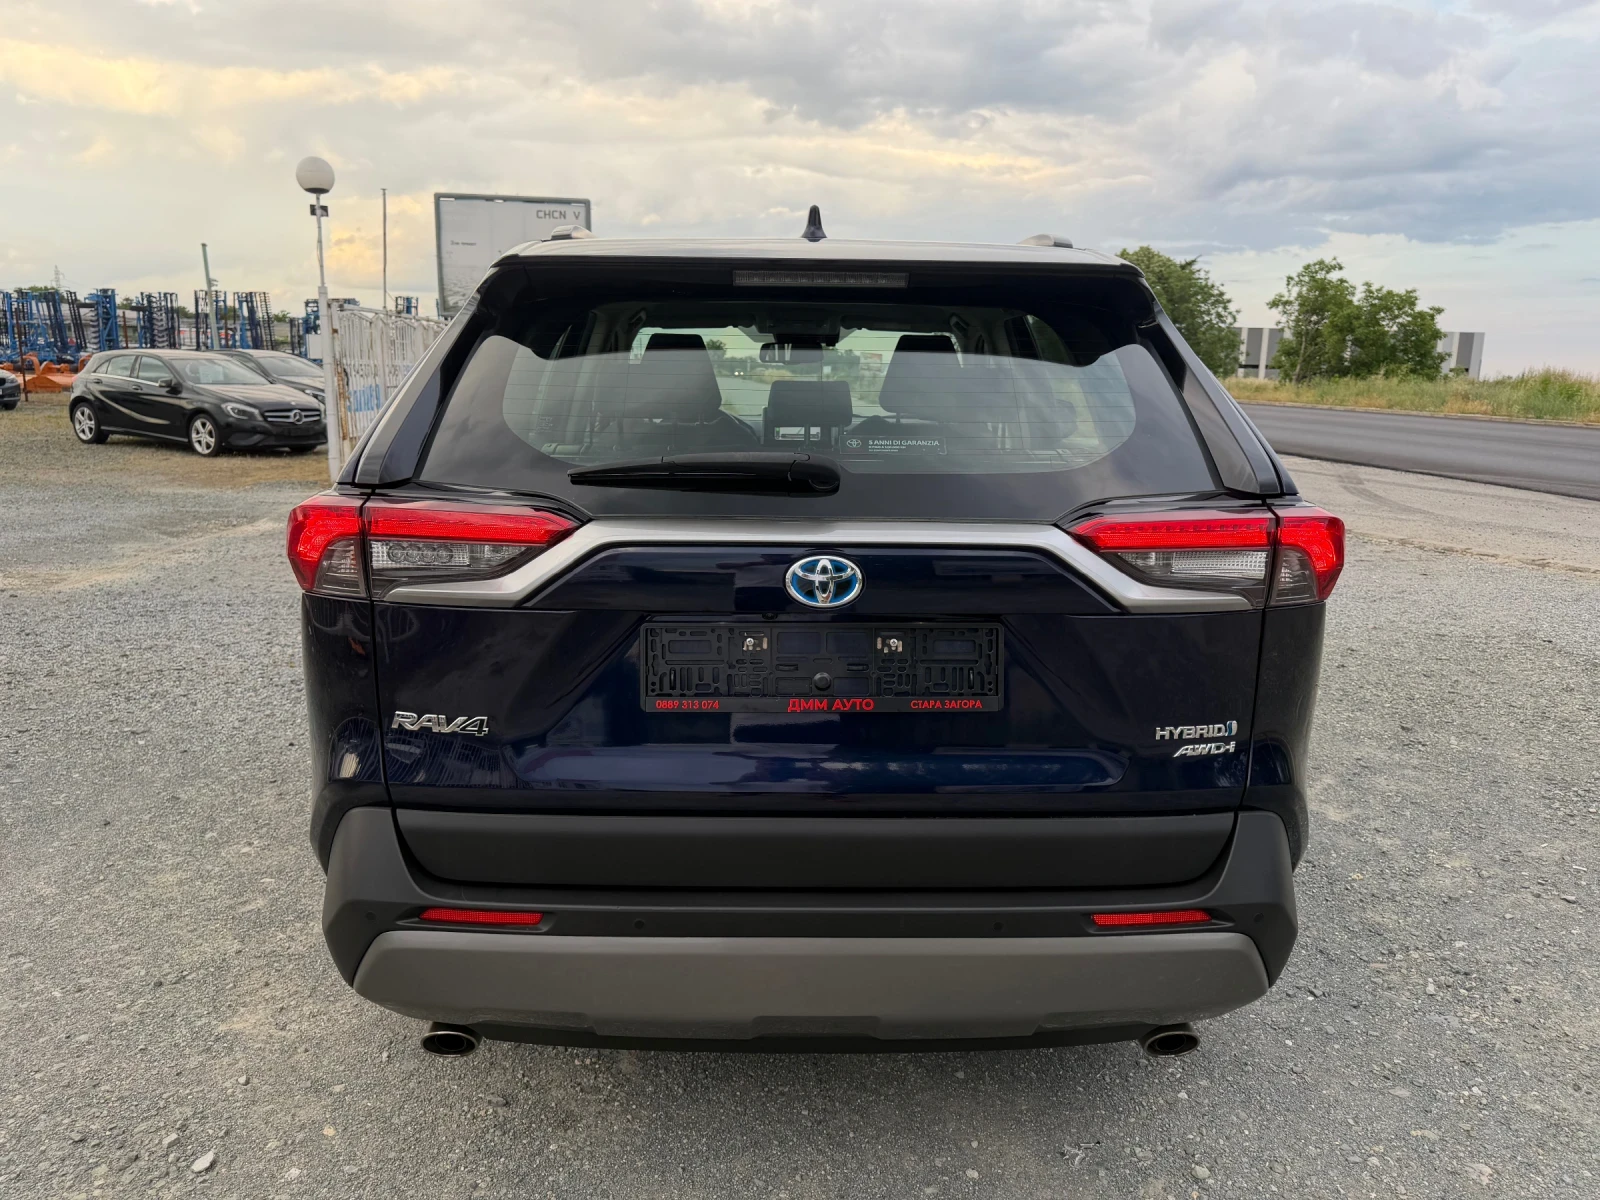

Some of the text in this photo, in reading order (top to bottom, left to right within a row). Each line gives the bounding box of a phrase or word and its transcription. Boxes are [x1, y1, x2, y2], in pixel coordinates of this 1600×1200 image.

[892, 439, 901, 447] DI
[655, 700, 719, 710] 0889 313 074
[787, 698, 875, 713] ДММ АУТО
[910, 700, 983, 709] СТАРА ЗАГОРА
[391, 710, 489, 737] RAV4
[1155, 723, 1227, 740] HYBRID
